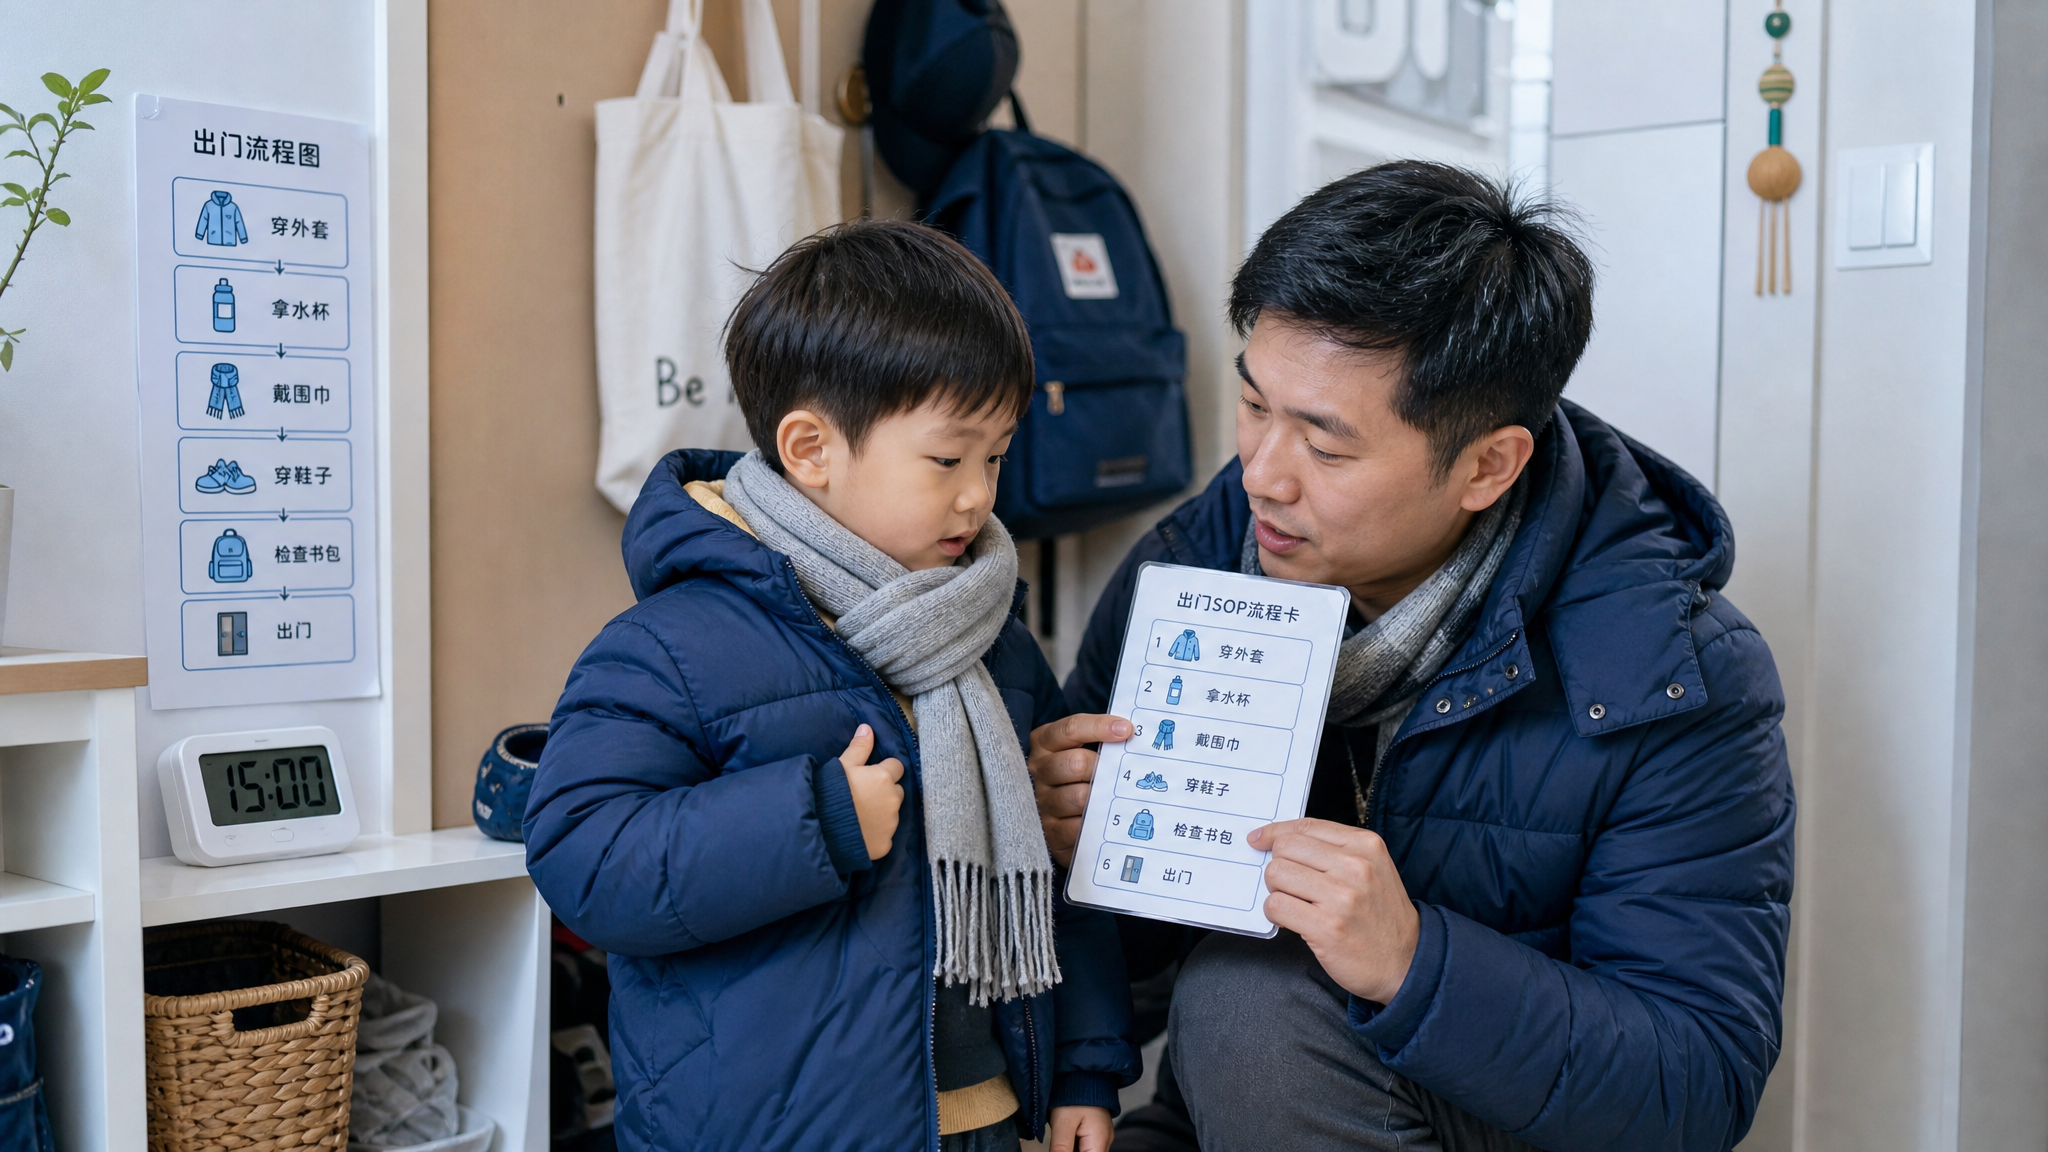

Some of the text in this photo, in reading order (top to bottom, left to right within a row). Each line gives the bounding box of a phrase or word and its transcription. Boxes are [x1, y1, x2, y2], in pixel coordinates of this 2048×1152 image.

[193, 127, 320, 169] 出门流程图
[271, 215, 329, 241] 穿外套
[271, 298, 330, 322] 拿水杯
[272, 383, 330, 405] 戴围巾
[656, 357, 705, 407] Be
[274, 465, 333, 487] 穿鞋子
[274, 544, 341, 564] 检查书包
[1176, 591, 1301, 625] 出门SOP流程卡
[276, 621, 312, 640] 出门
[1155, 636, 1265, 665] 1 穿外套
[1144, 680, 1252, 708] 2 拿水杯
[1134, 724, 1240, 752] 3 戴围巾
[226, 755, 327, 814] 15:00
[1122, 769, 1230, 797] 4 穿鞋子
[1112, 814, 1233, 846] 5 检查书包
[1102, 858, 1193, 886] 6 出门
